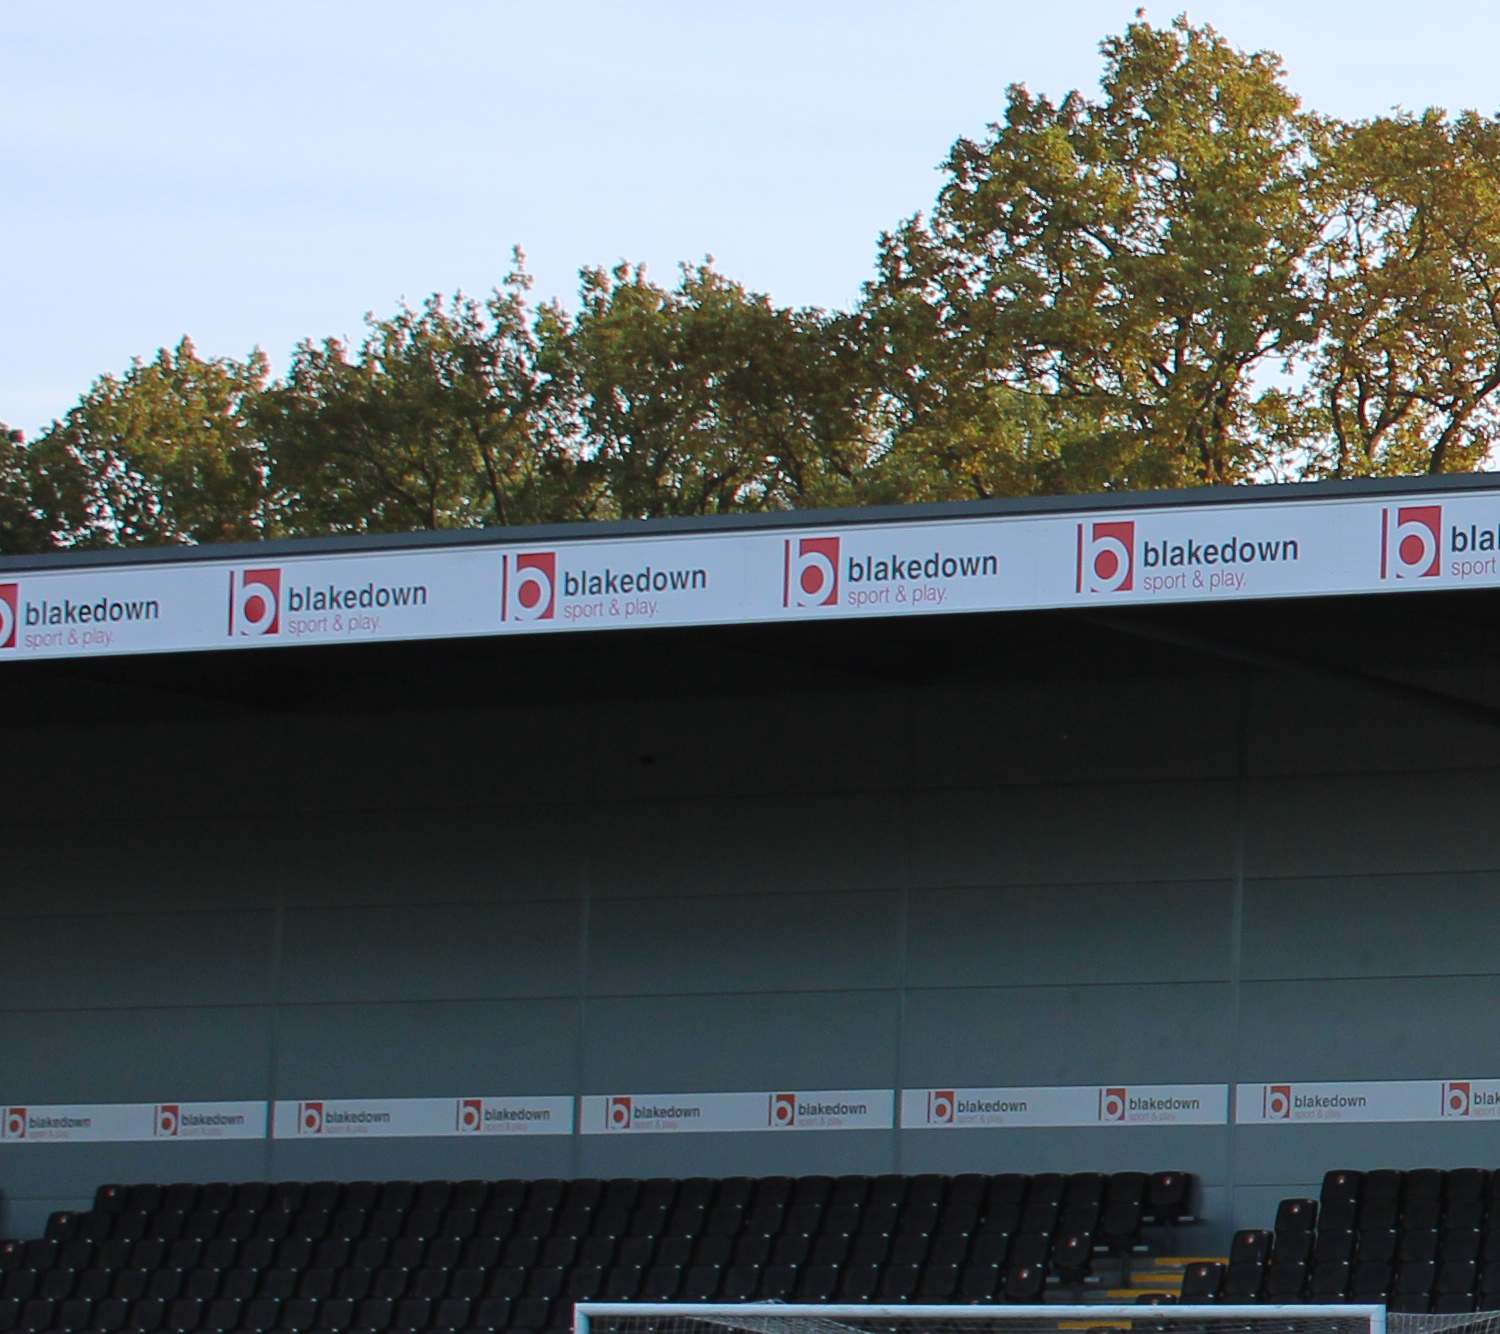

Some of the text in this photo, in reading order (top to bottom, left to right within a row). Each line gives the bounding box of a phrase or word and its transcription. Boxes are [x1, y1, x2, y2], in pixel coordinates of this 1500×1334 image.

[1144, 536, 1298, 568] blakedown
[848, 551, 997, 583] blakedown
[1452, 557, 1496, 580] sport
[564, 566, 706, 597] blakedown
[1144, 569, 1246, 594] sport & play.
[288, 582, 427, 612] blakedown
[848, 584, 947, 609] sport & play.
[25, 597, 159, 627] blakedown
[564, 601, 603, 622] sport
[609, 598, 620, 617] &
[288, 617, 327, 637] sport
[333, 614, 343, 632] &
[26, 631, 63, 650] sport
[68, 628, 78, 645] &
[798, 1102, 866, 1114] blakedown
[958, 1100, 1026, 1112] blakedown
[1130, 1097, 1199, 1110] blakedown
[1295, 1095, 1366, 1108] blakedown
